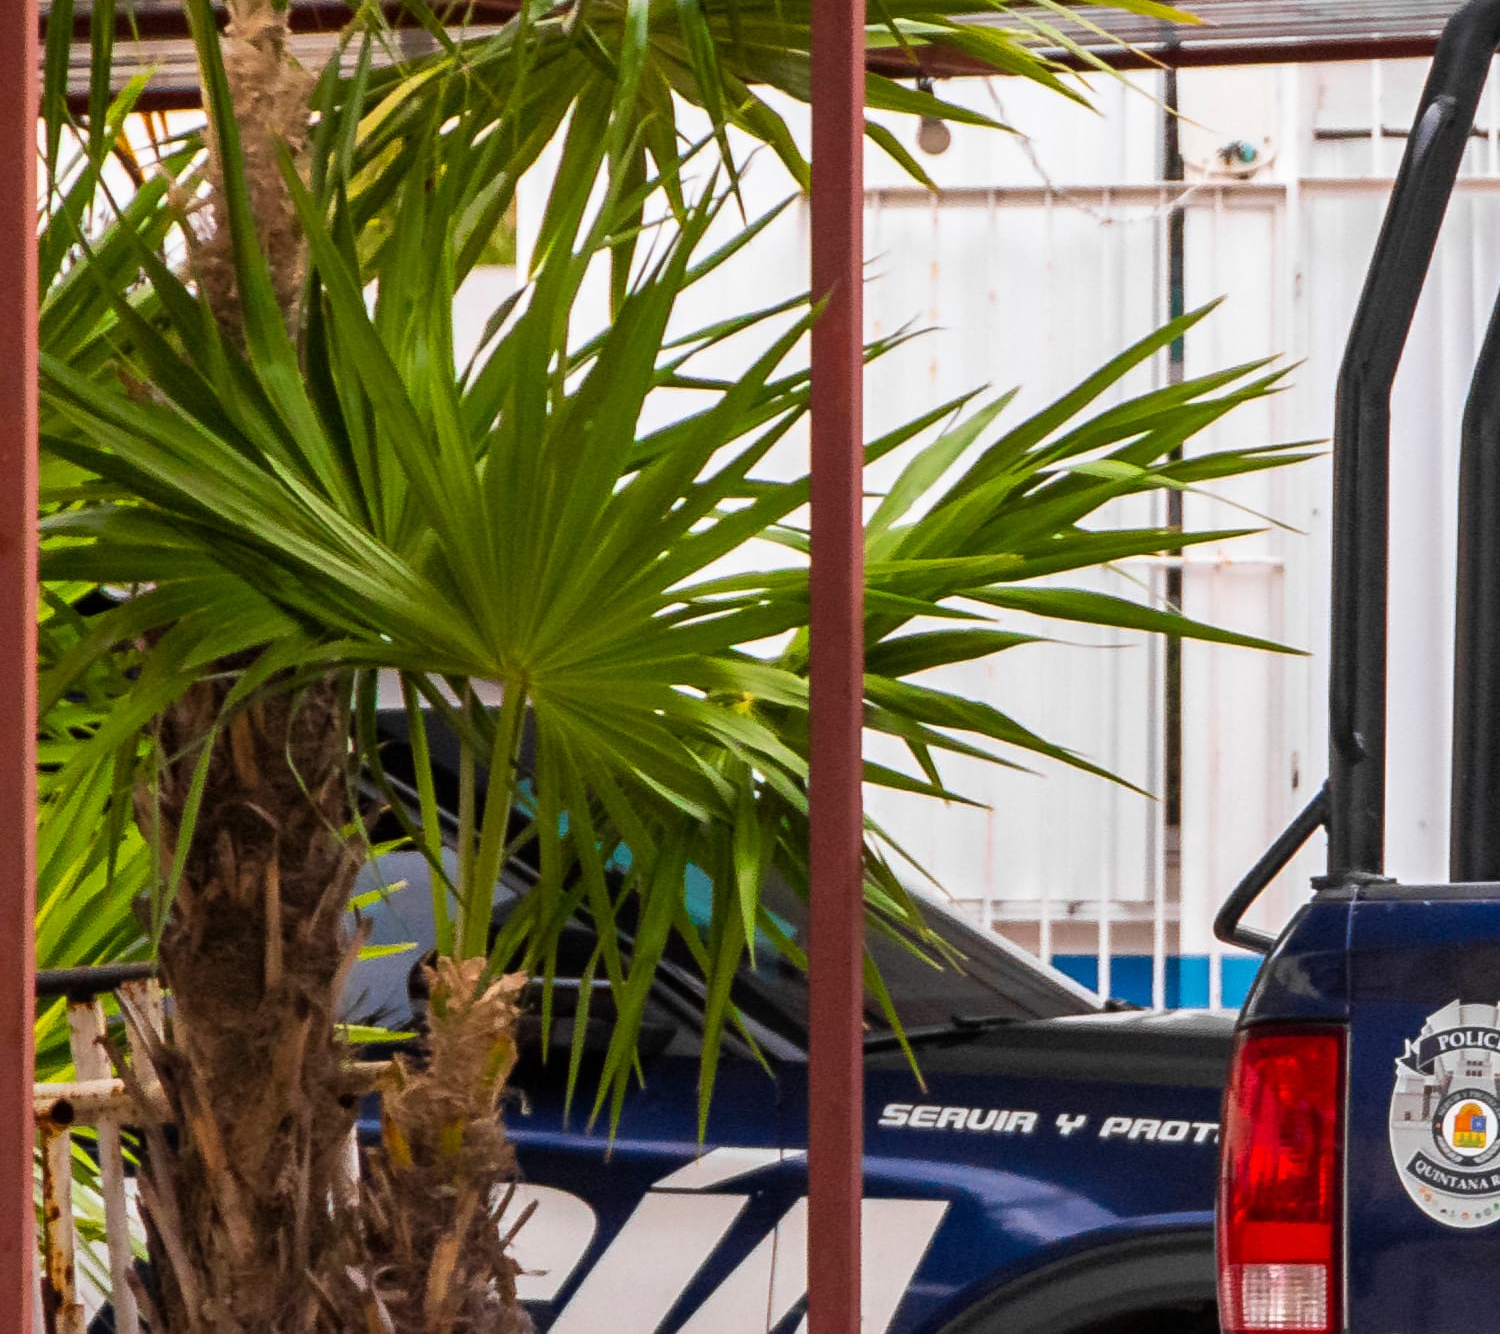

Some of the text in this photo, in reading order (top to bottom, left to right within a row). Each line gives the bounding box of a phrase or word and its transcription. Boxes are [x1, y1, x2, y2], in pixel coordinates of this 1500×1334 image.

[1055, 1113, 1087, 1135] Y
[1099, 1117, 1219, 1143] PROT
[1415, 1159, 1489, 1191] QUINTANA
